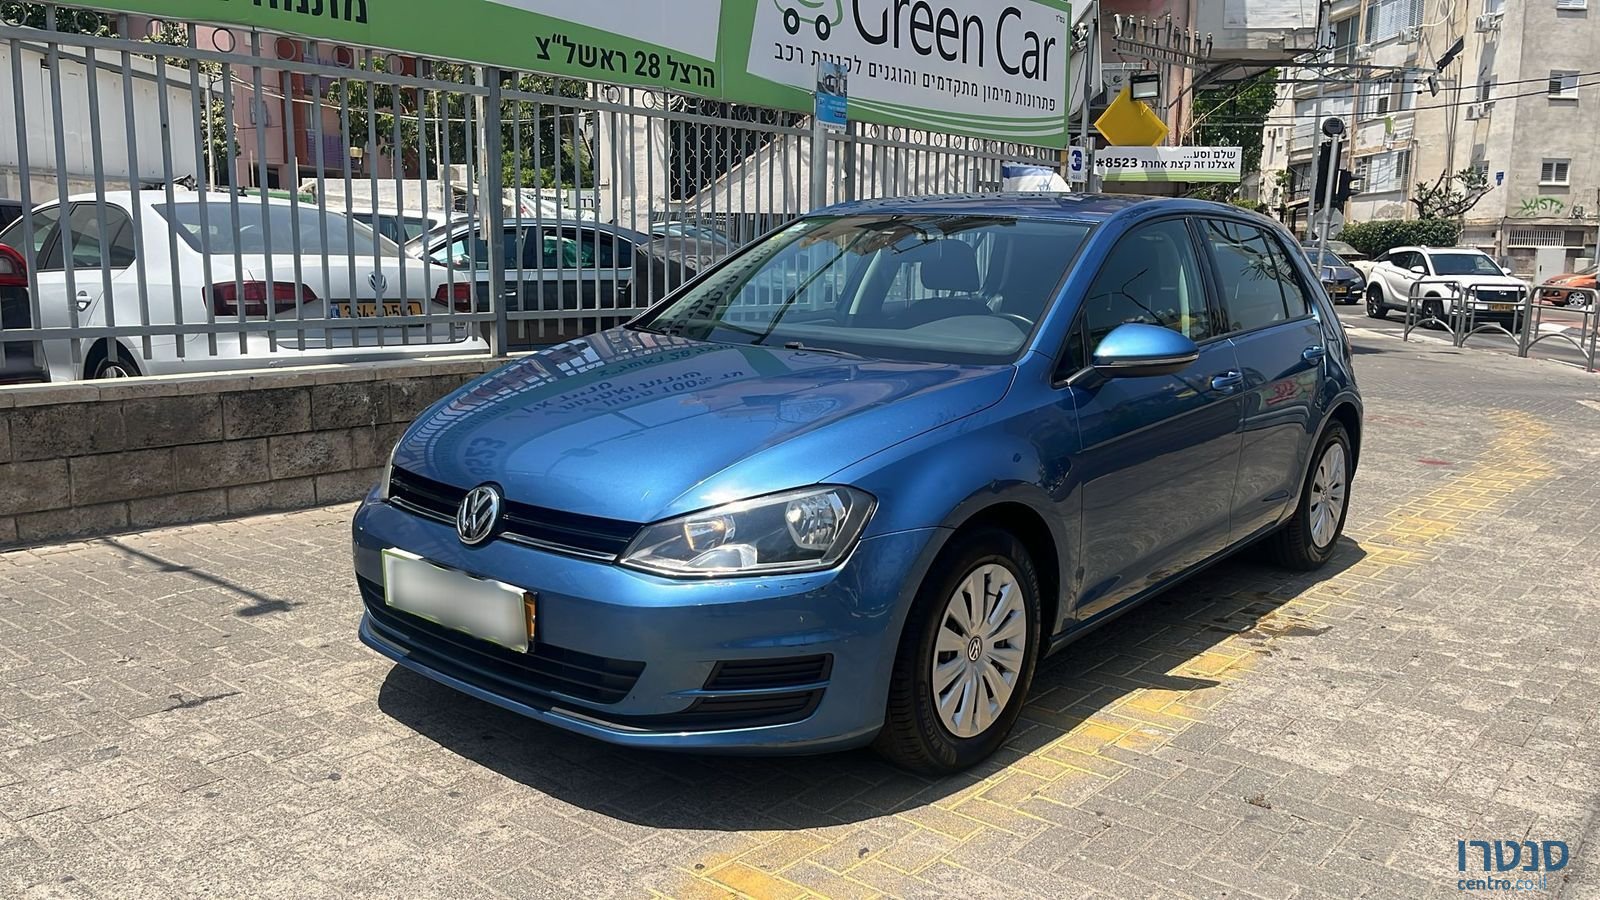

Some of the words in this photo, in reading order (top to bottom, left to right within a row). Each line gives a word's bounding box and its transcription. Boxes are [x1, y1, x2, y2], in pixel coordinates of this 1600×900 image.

[852, 0, 984, 67] Green
[996, 6, 1056, 81] Car
[774, 42, 804, 64] רכב
[634, 50, 661, 78] 28
[666, 55, 715, 88] הרצל
[868, 62, 917, 86] והוגנים
[922, 73, 978, 98] מתקדמים
[983, 84, 1012, 103] מימון
[1016, 91, 1056, 111] פתרונות
[1141, 160, 1168, 169] אחרת
[1194, 160, 1205, 169] זה
[1207, 160, 1235, 169] אצלנו
[1213, 150, 1236, 159] שלם
[1170, 160, 1191, 170] קצת
